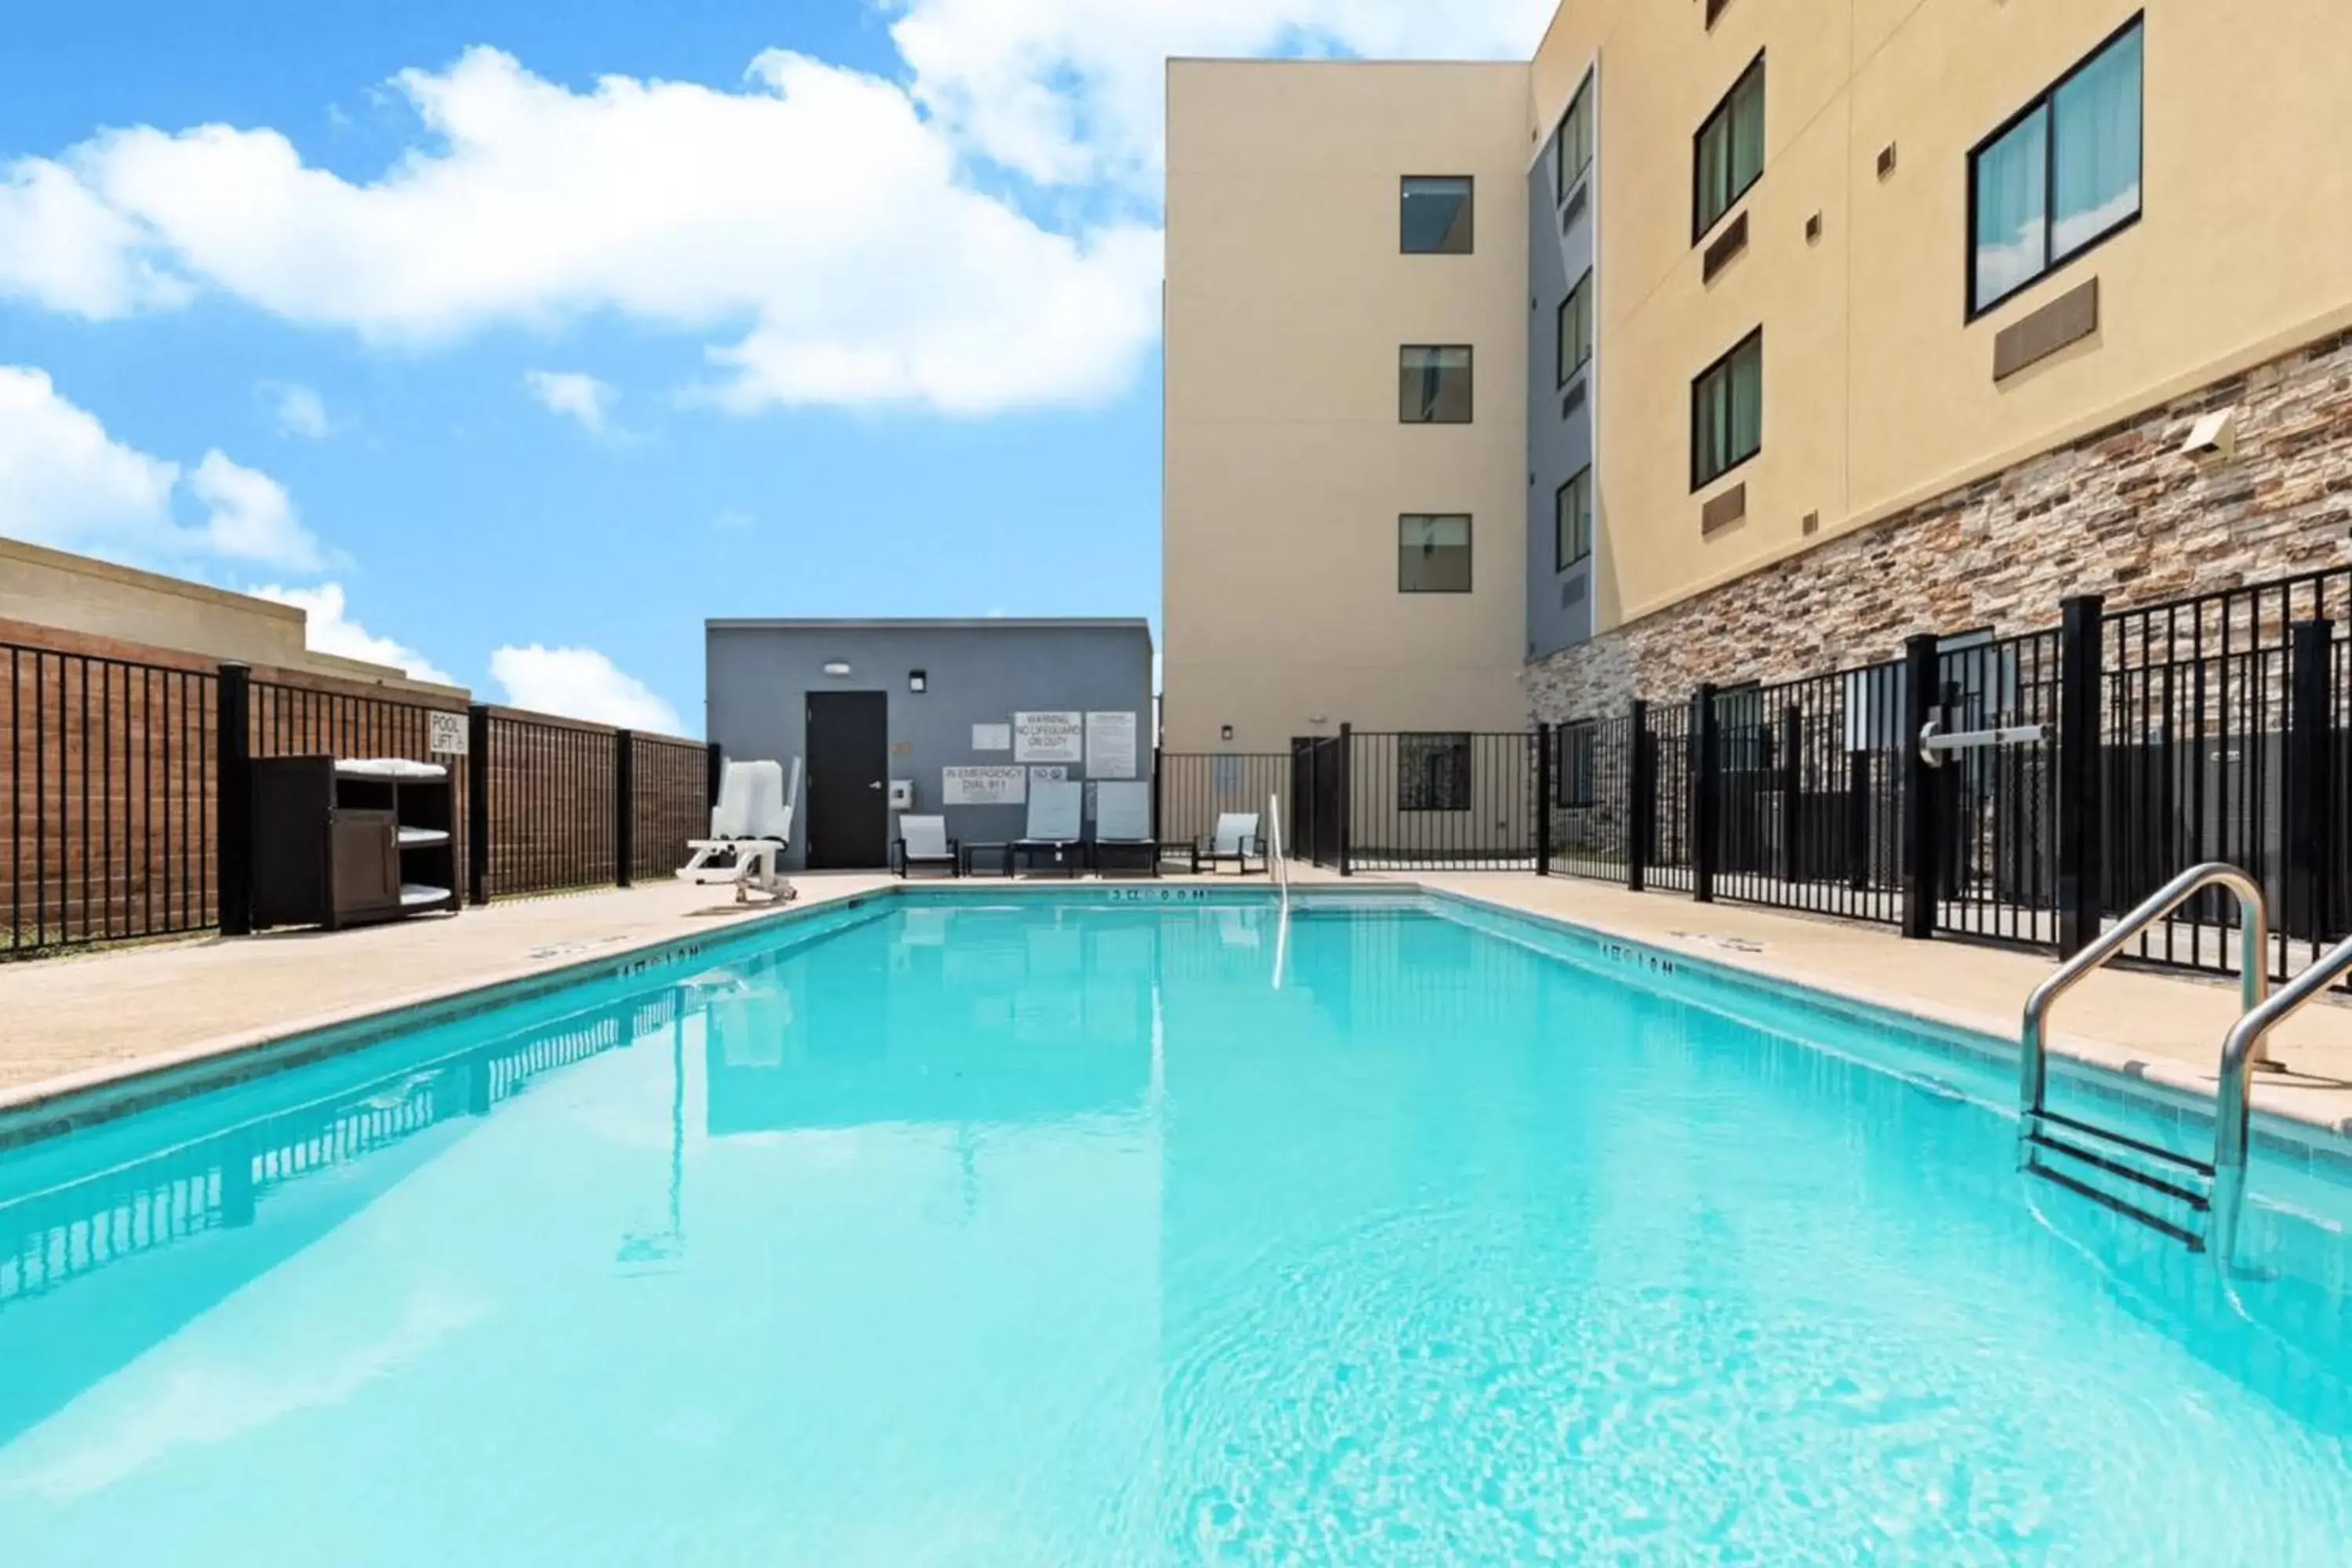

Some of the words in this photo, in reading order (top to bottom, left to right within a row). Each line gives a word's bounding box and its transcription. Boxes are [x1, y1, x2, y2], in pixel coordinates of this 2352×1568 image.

[433, 714, 459, 733] POOL
[1016, 725, 1030, 735] NO
[1032, 725, 1080, 735] LIFEGUARD
[432, 733, 454, 750] LIFT
[1028, 737, 1042, 746] ON
[1044, 737, 1069, 747] DUTY
[960, 769, 1023, 779] EMERGENCY
[962, 779, 986, 791] DIAL
[989, 780, 1007, 792] 911
